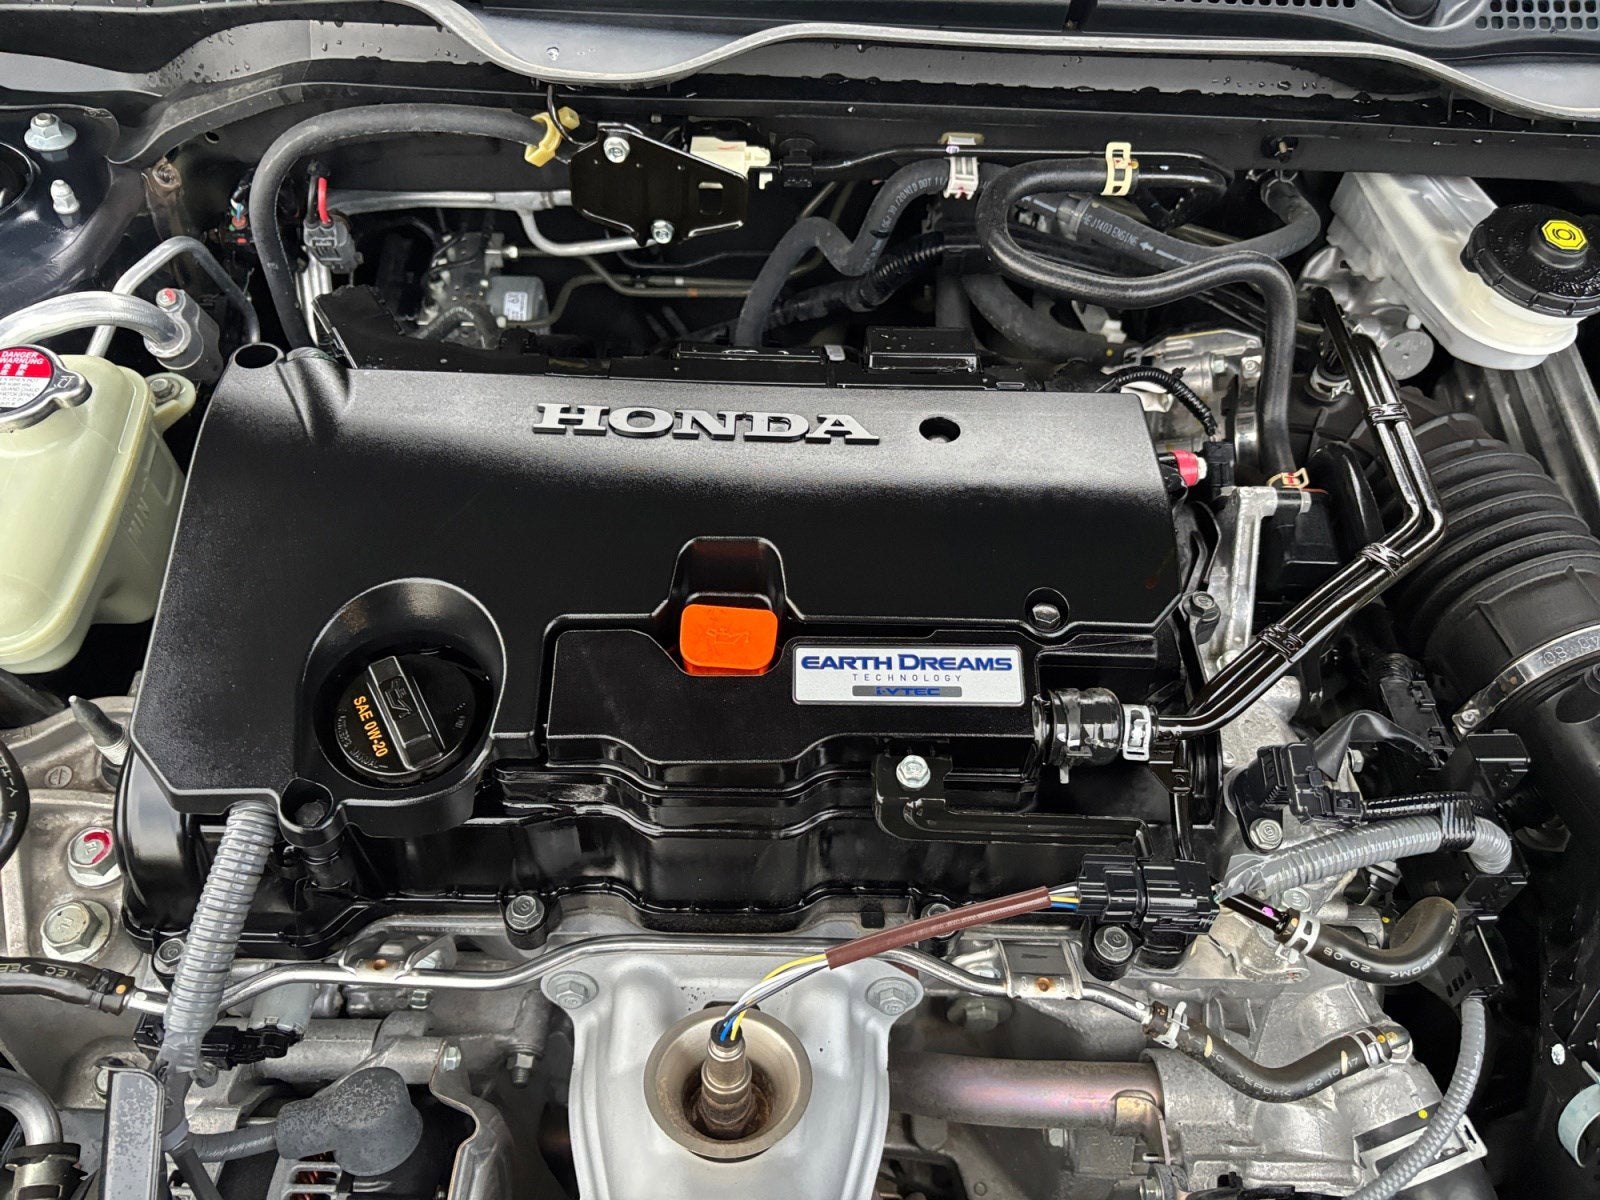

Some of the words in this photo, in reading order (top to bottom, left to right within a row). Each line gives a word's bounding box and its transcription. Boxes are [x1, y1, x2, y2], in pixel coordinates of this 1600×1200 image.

[1111, 226, 1139, 247] ENGINE
[1, 351, 39, 359] DANGER
[533, 402, 880, 445] HONDA
[801, 655, 892, 671] EARTH
[897, 653, 1013, 672] DREAMS
[852, 673, 962, 683] TECHNOLOGY
[353, 695, 374, 722] SAE
[363, 720, 389, 758] 0W-20
[1305, 1078, 1323, 1092] 20
